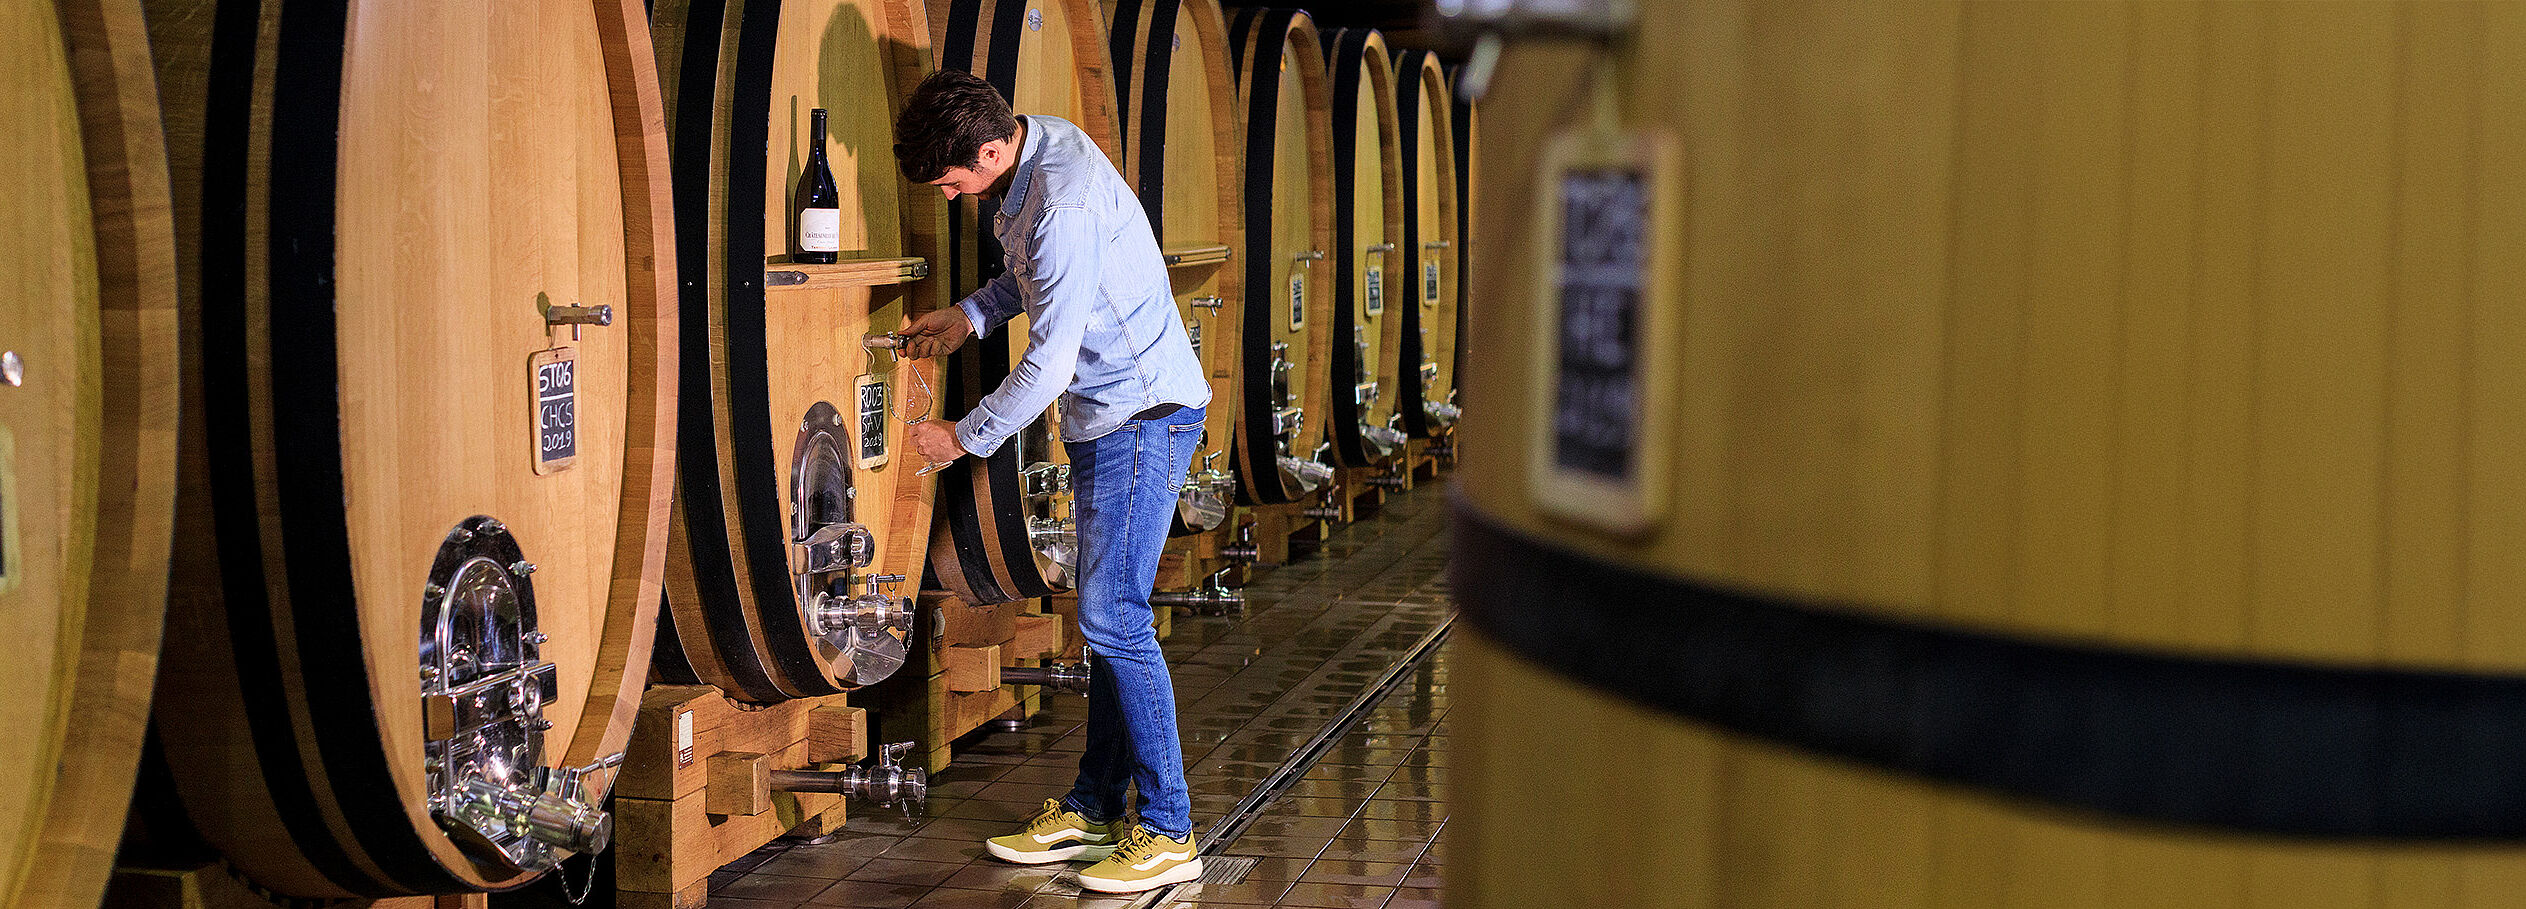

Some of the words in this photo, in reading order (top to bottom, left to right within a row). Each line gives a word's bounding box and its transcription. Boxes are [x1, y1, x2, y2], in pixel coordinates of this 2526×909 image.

[539, 361, 572, 392] ST06
[541, 401, 573, 429] CHCS
[862, 416, 882, 435] SAV
[543, 430, 572, 452] 2019
[864, 432, 882, 448] 2019
